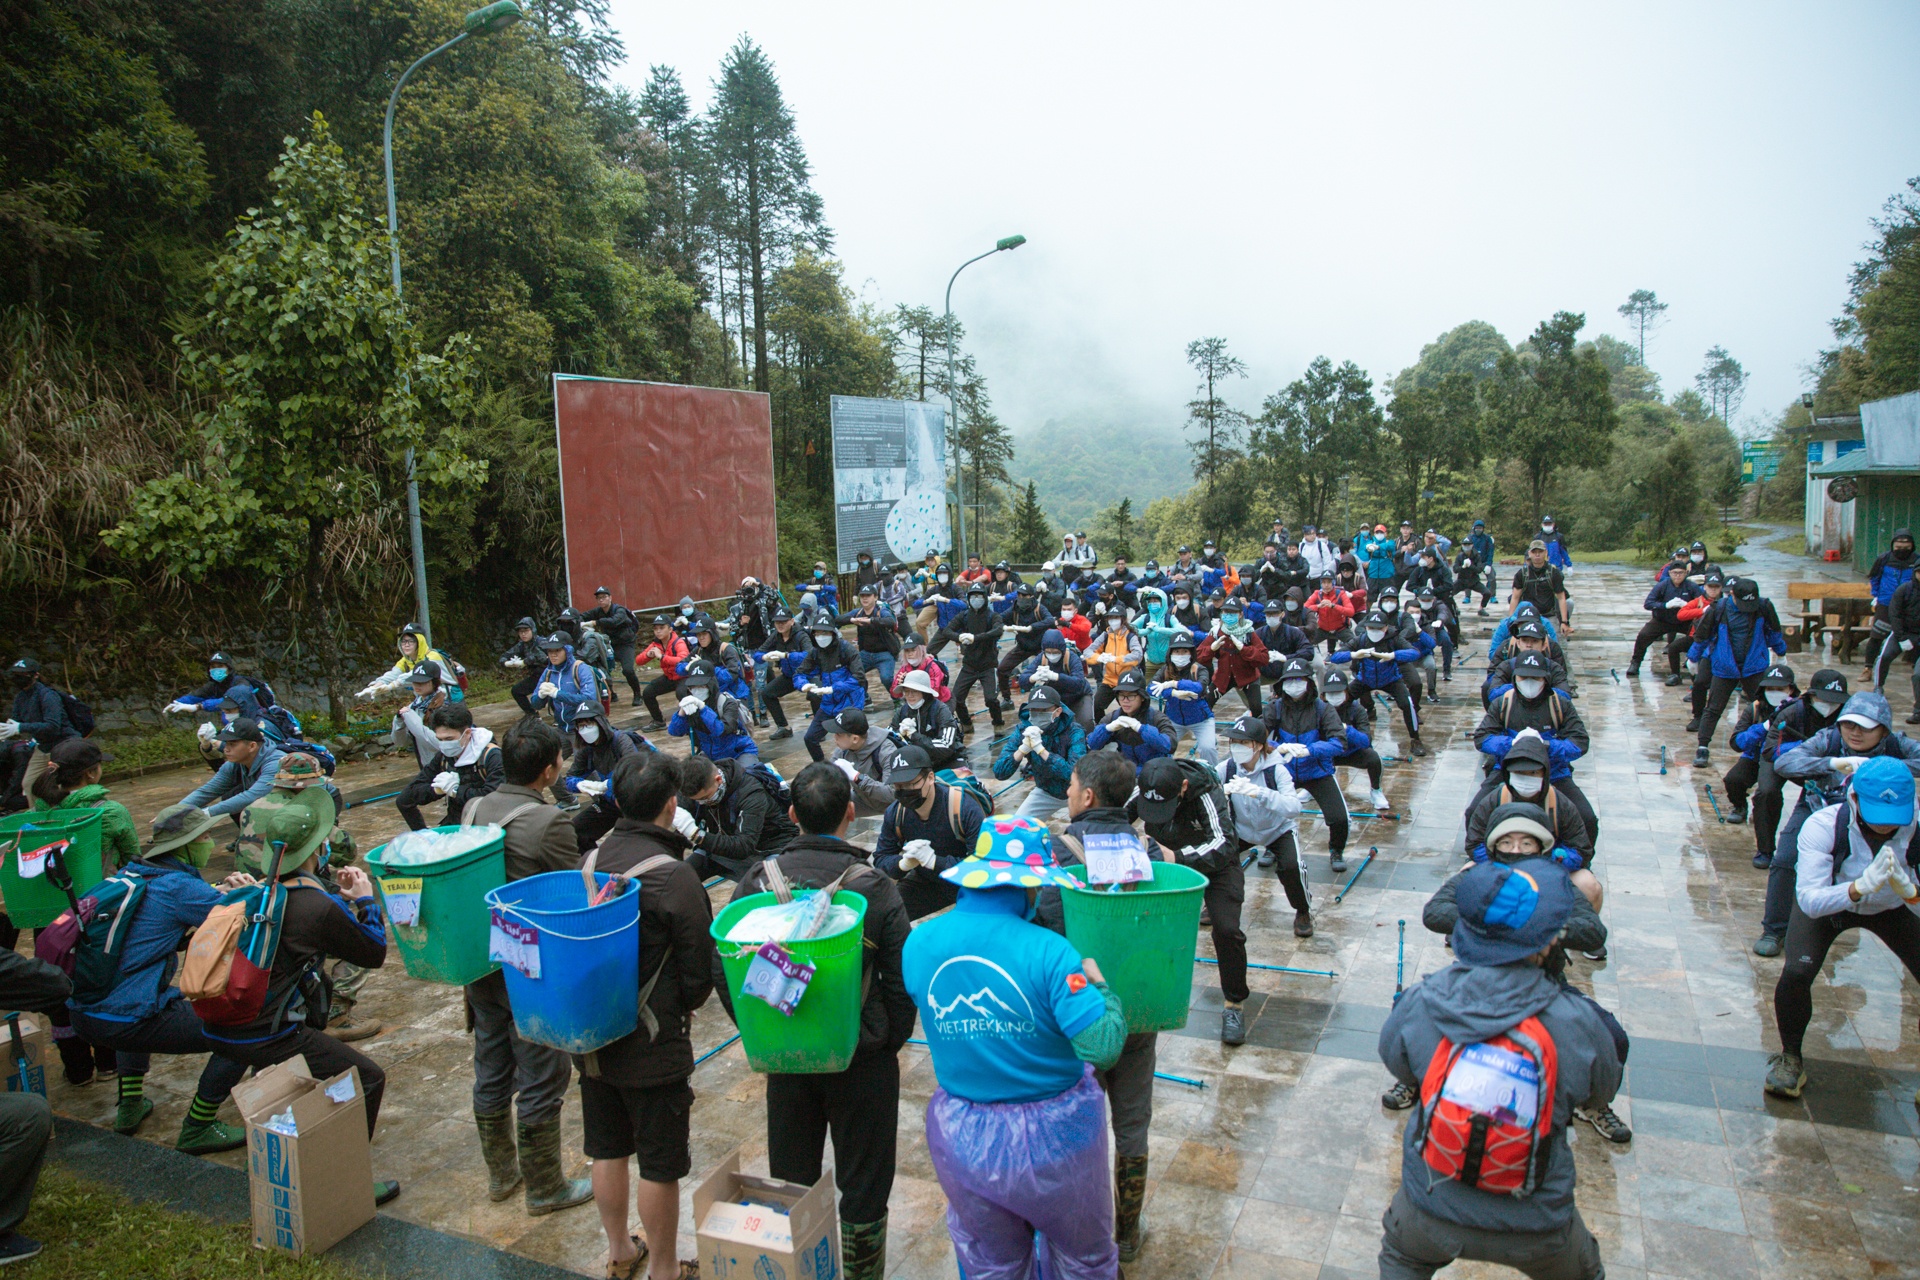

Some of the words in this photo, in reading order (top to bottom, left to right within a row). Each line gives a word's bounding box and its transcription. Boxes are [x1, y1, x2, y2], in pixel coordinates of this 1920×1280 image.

[1096, 857, 1117, 873] 04
[387, 883, 406, 892] TEAM
[767, 948, 779, 962] T5
[934, 1018, 1035, 1034] VIET-TREKKING
